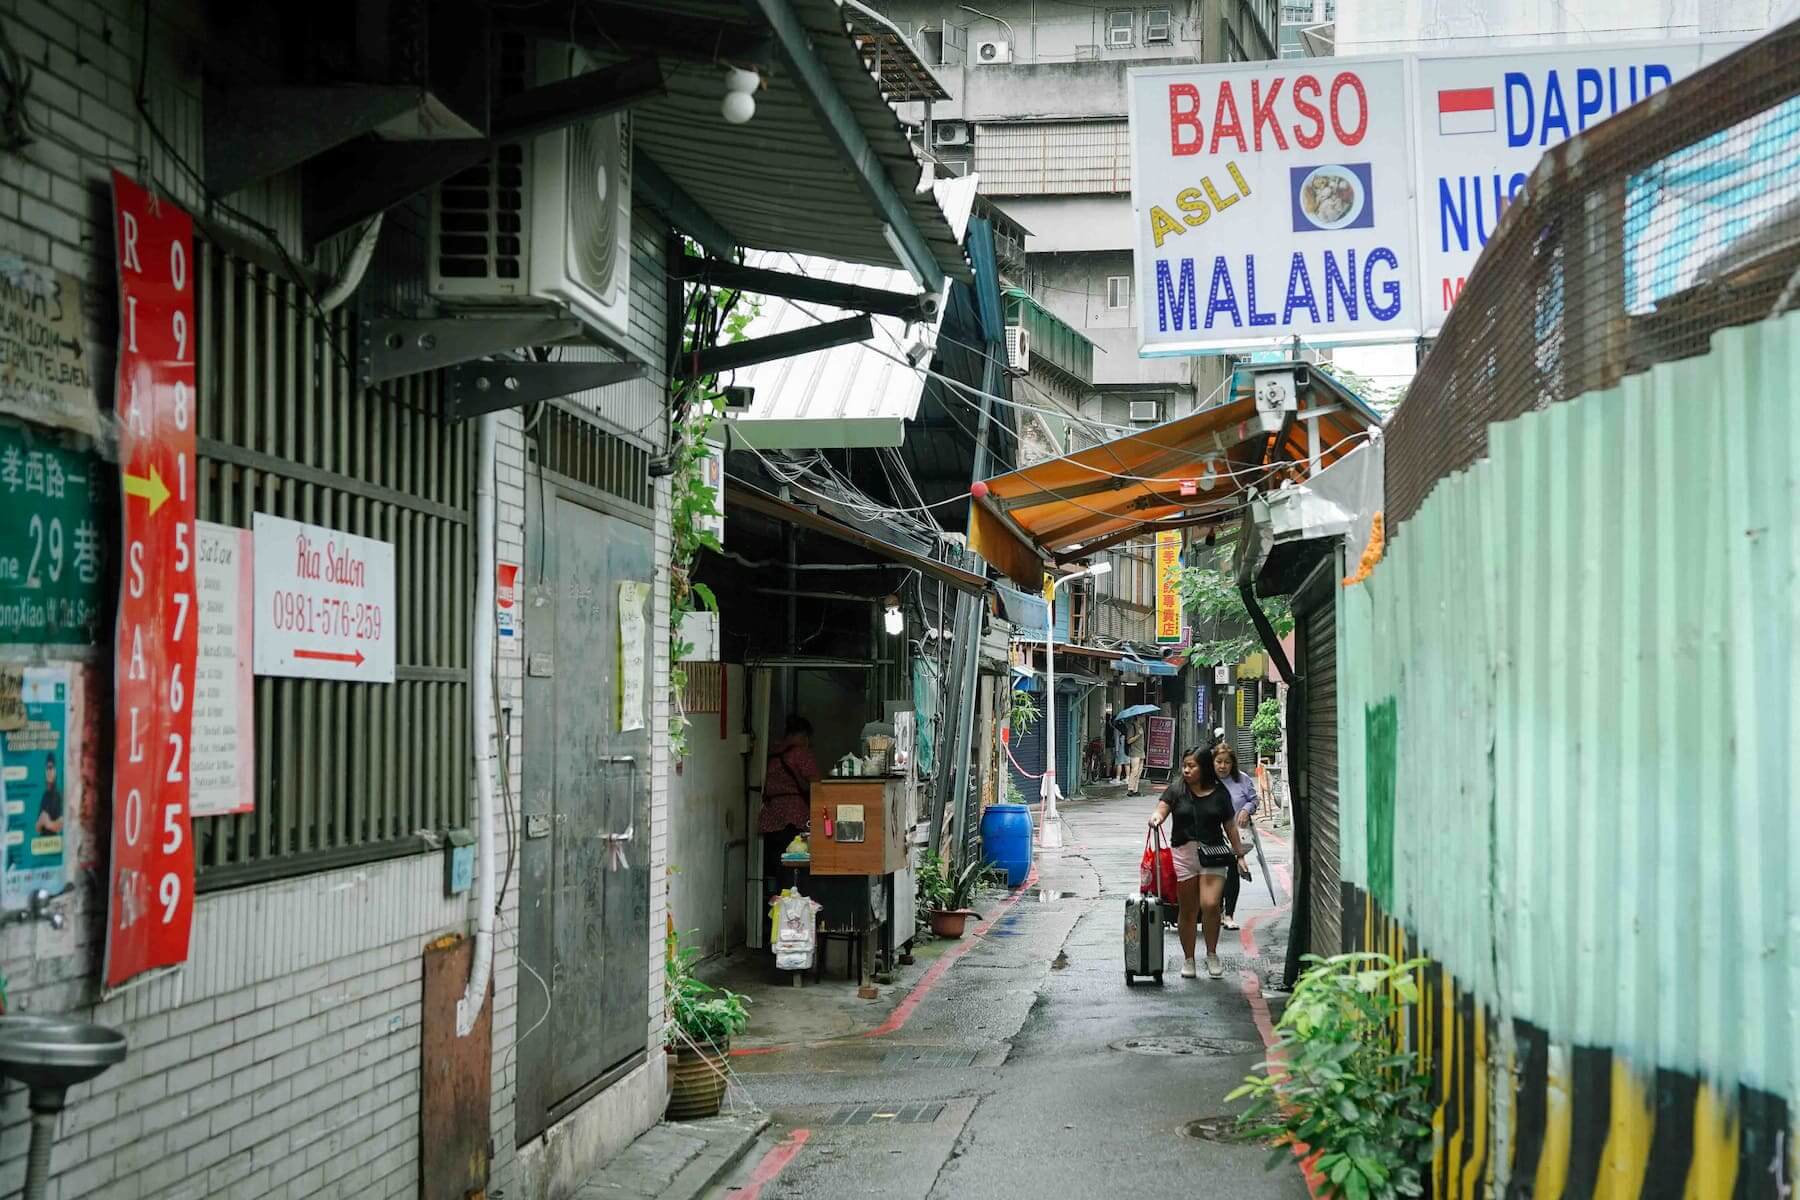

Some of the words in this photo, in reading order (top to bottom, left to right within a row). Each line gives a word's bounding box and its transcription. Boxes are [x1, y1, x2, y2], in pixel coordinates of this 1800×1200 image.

[1168, 71, 1369, 157] BAKSO
[1504, 64, 1672, 148] DAP
[1149, 161, 1252, 248] ASLI
[123, 210, 145, 437] RIA
[1156, 247, 1402, 332] MALANG
[158, 240, 190, 925] 0981576259
[296, 533, 320, 579] Ria
[325, 541, 365, 588] Salon
[273, 590, 381, 641] 0981-576-259
[118, 540, 147, 930] SALON
